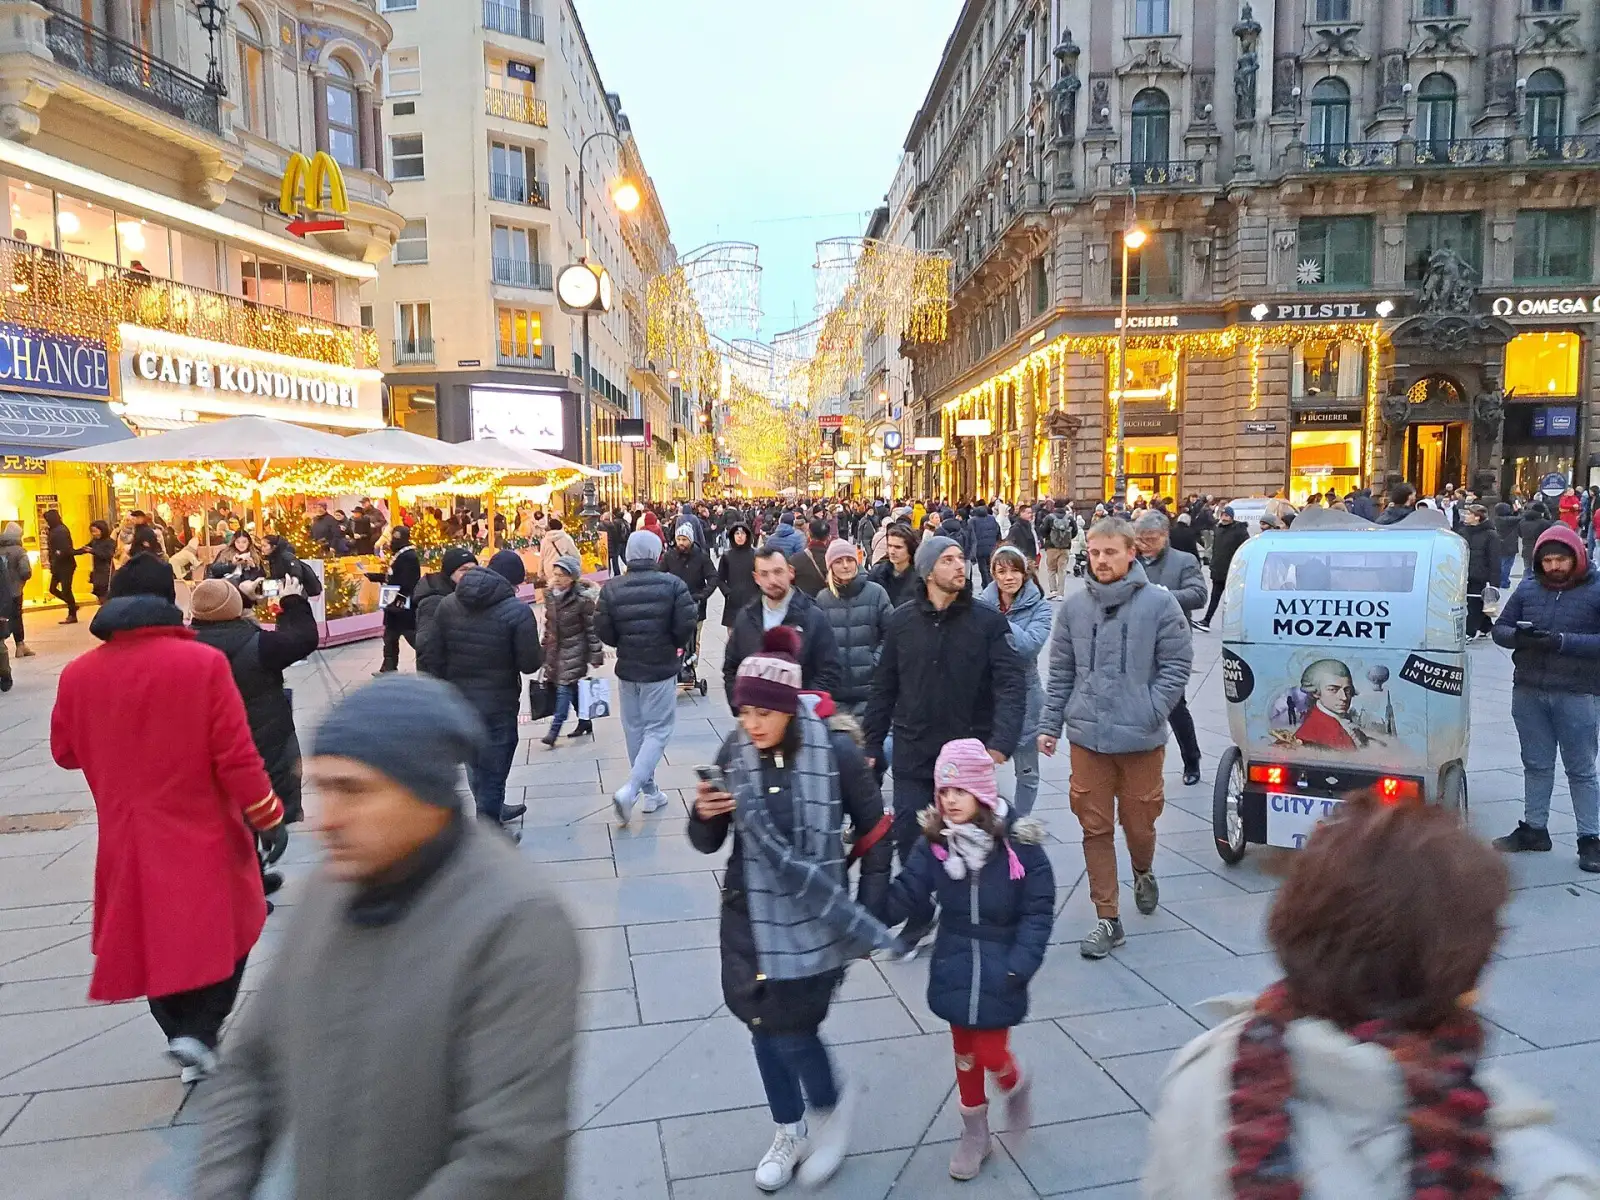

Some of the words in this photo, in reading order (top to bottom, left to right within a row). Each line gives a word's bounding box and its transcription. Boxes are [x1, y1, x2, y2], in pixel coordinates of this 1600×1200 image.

[1277, 304, 1366, 318] PILSTL
[1518, 298, 1588, 315] OMEGA
[218, 363, 359, 408] KONDITOREI
[28, 405, 101, 424] GROUP
[1275, 598, 1390, 618] MYTHOS
[1273, 618, 1391, 639] MOZART
[1413, 660, 1448, 677] MUST
[1405, 668, 1419, 679] IN
[1423, 675, 1461, 692] VIENNA
